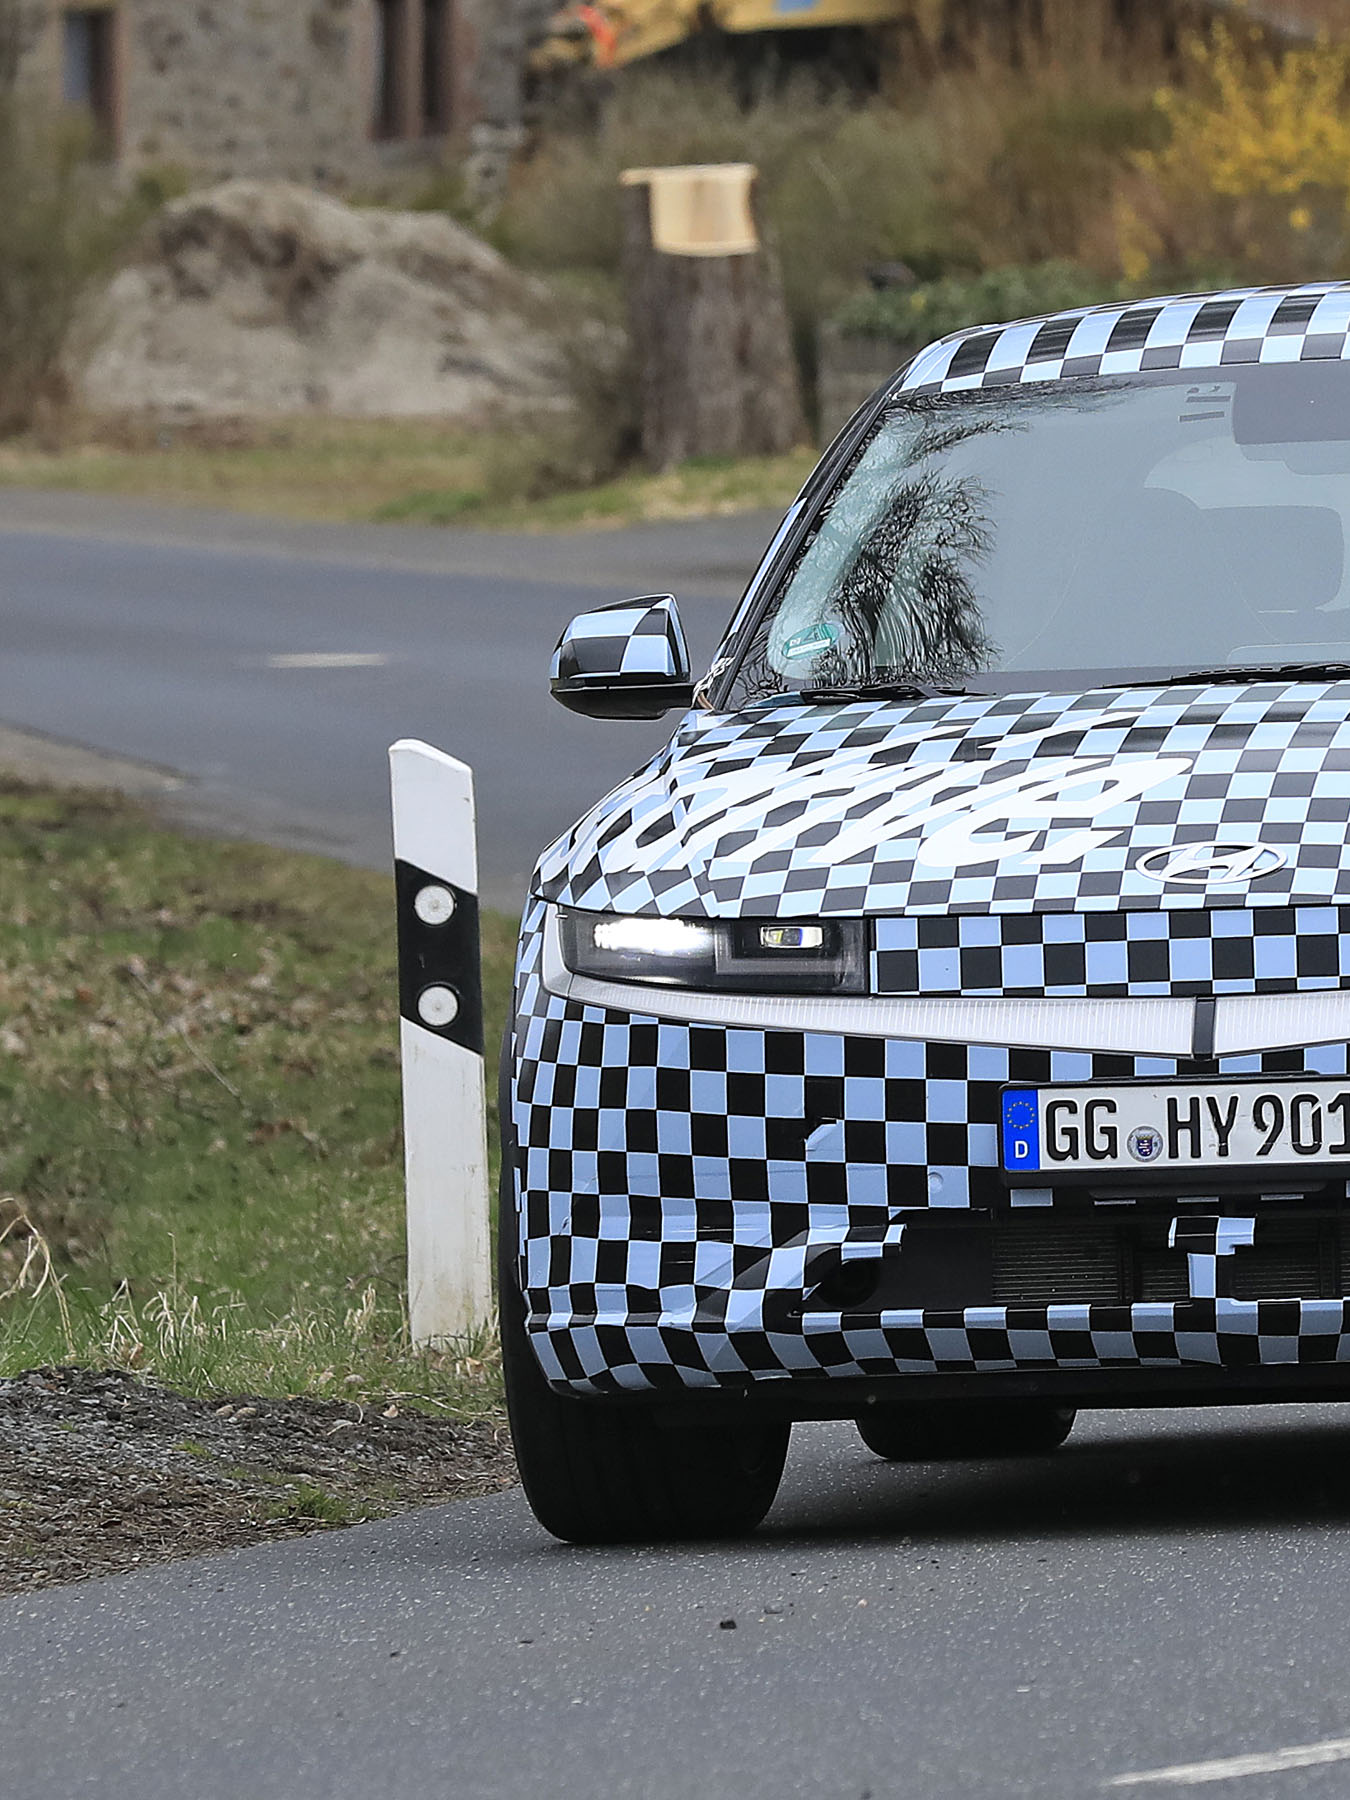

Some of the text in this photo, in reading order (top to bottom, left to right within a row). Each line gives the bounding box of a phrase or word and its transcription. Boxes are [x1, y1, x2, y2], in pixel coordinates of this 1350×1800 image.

[1045, 1098, 1118, 1160] GG
[1168, 1095, 1239, 1159] HY
[1014, 1140, 1028, 1159] D
